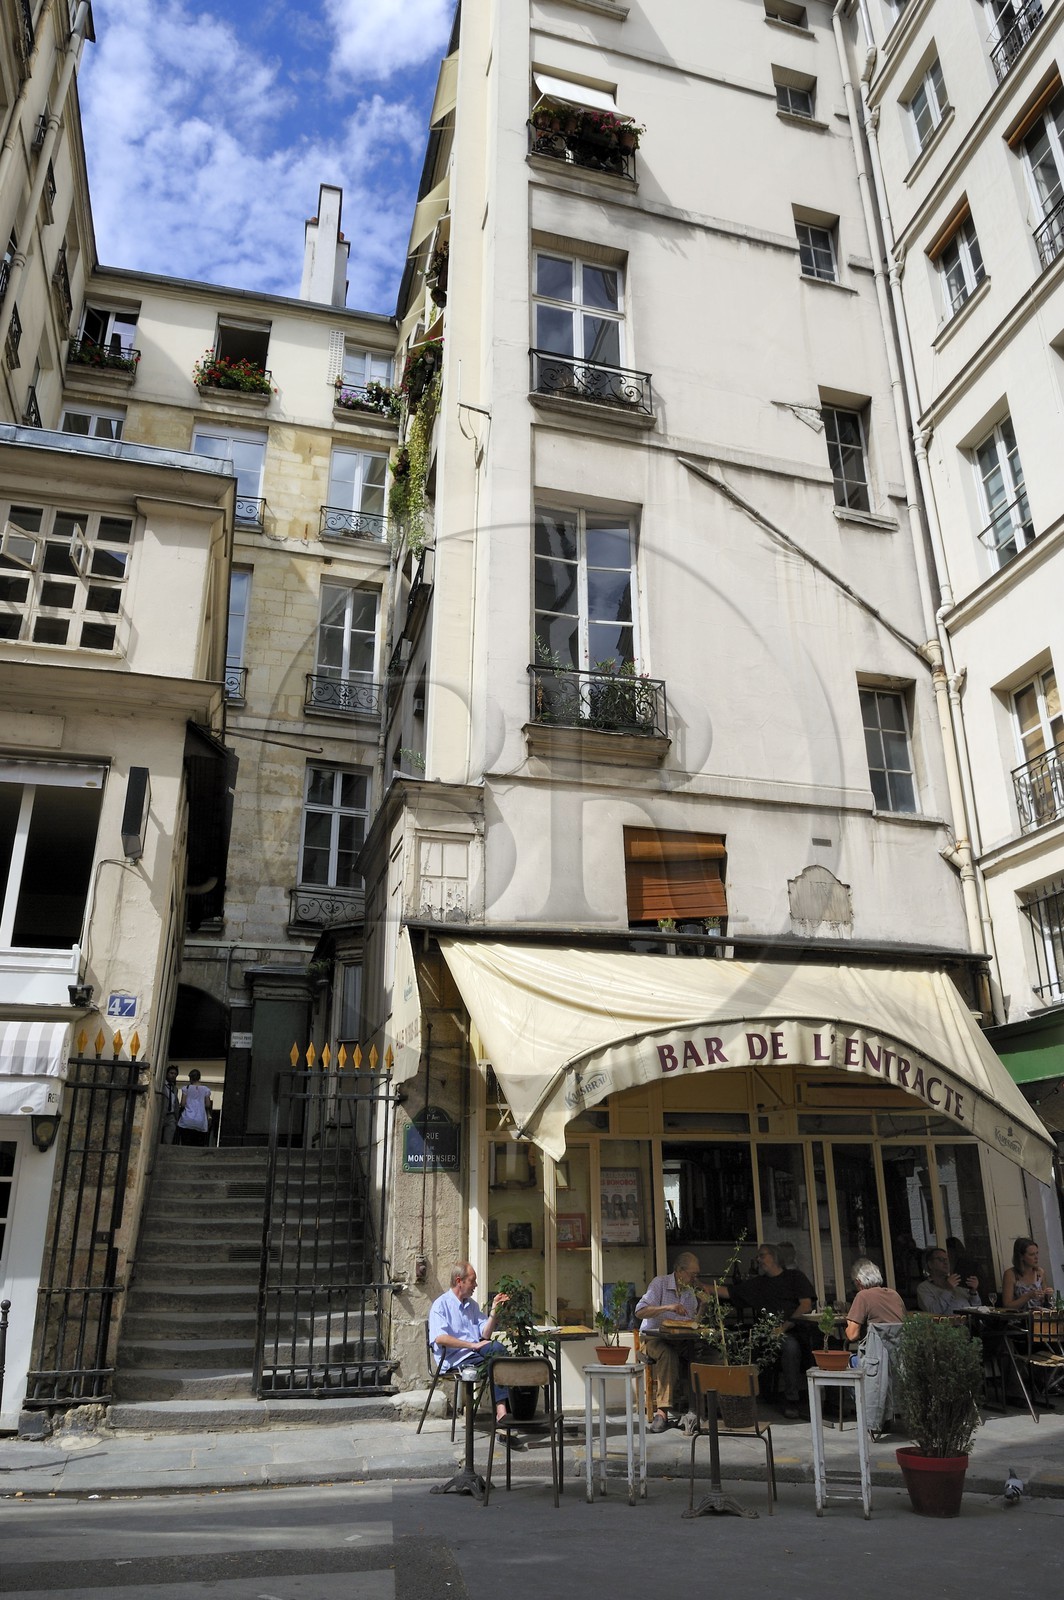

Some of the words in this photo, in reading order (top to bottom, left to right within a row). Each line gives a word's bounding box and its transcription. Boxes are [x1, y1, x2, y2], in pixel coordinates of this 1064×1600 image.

[109, 998, 135, 1016] 47
[656, 1036, 729, 1073] BAR
[745, 1031, 788, 1060] DE
[813, 1033, 965, 1121] L'ENTRACTE
[426, 1132, 440, 1140] RUE
